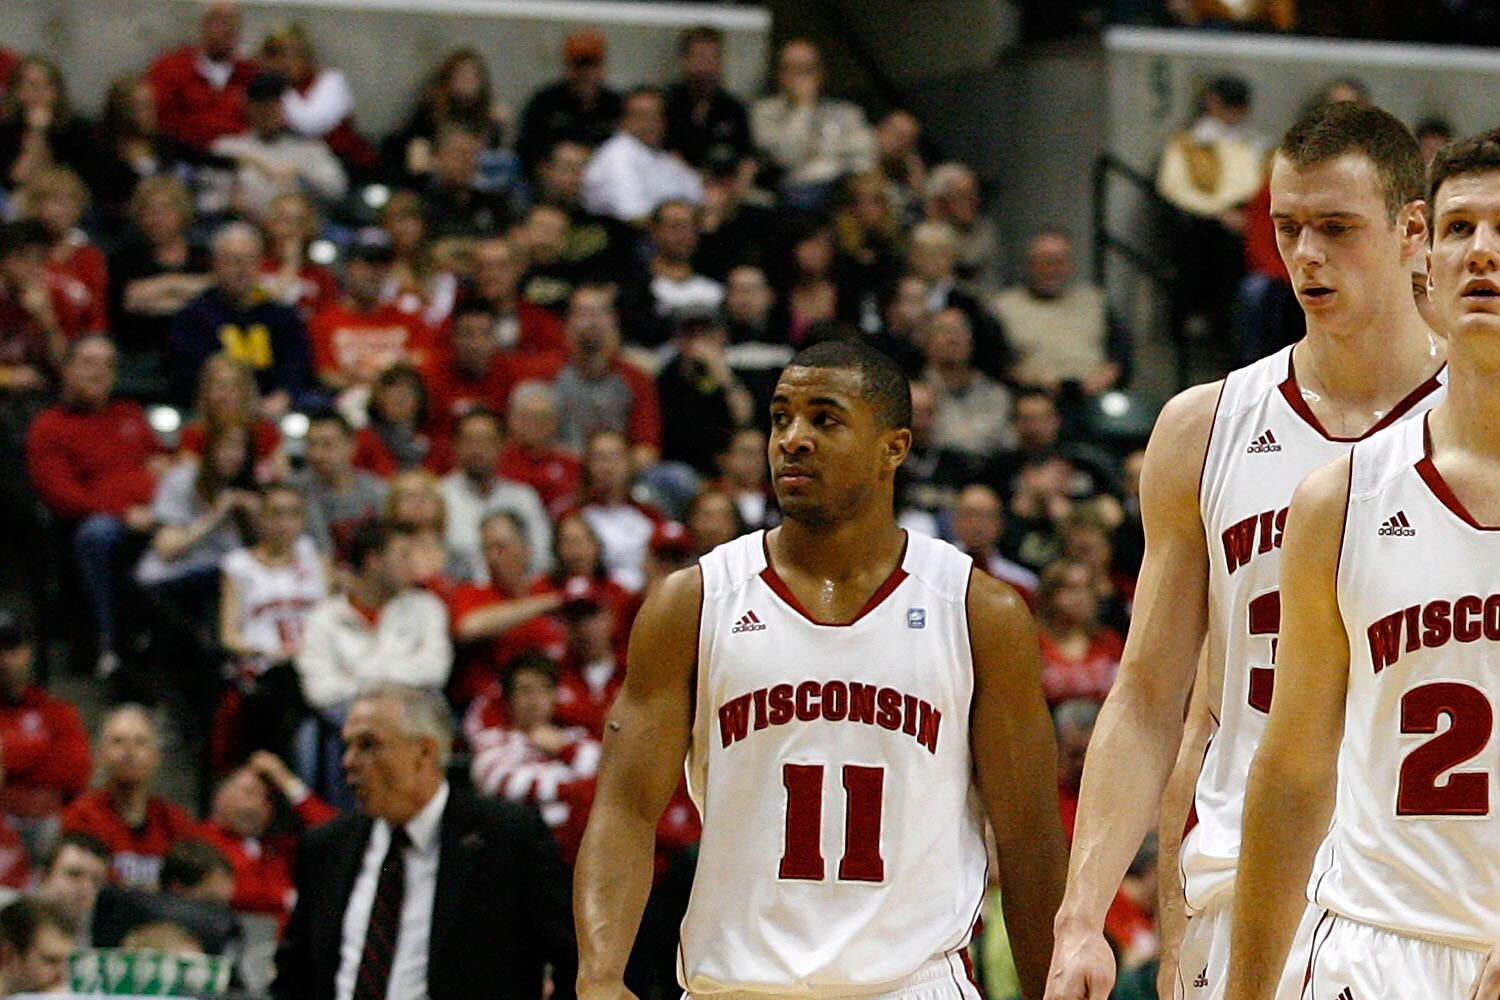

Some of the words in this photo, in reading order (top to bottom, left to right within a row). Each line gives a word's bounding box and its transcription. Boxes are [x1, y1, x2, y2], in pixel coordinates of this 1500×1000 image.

[1247, 442, 1282, 454] adidas
[1378, 525, 1416, 538] adidas
[731, 622, 767, 634] adidas
[718, 680, 942, 754] WISCONSIN
[778, 763, 885, 881] 11
